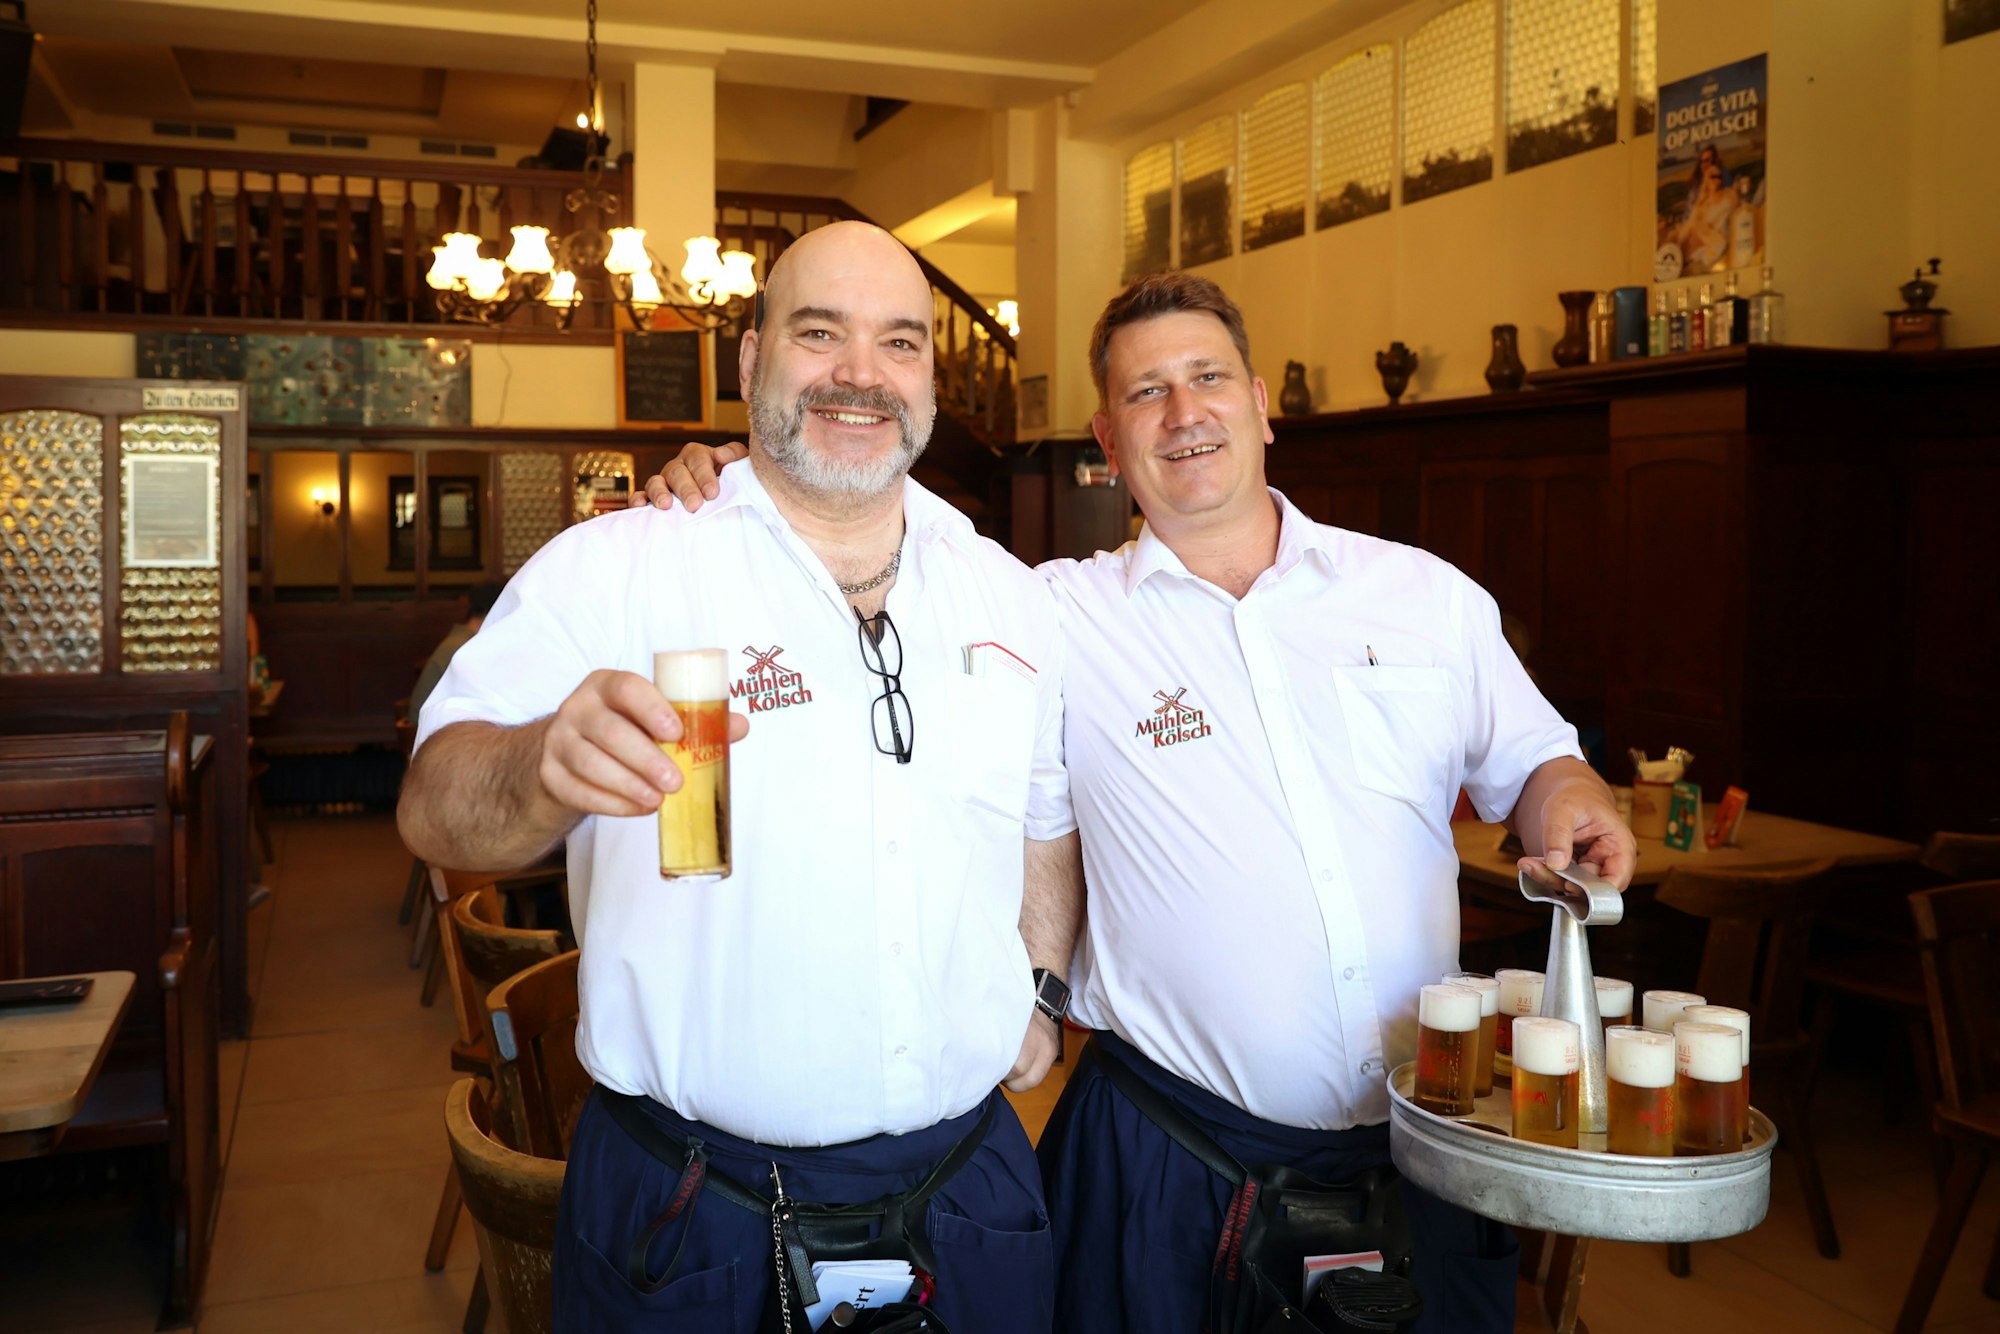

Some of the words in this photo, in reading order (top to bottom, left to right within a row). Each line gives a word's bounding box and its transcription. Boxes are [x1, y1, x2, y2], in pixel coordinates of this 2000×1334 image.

[1665, 97, 1716, 129] DOLCE
[1718, 86, 1760, 113] VITA
[1664, 128, 1689, 151] OP
[1690, 108, 1758, 143] KÖLSCH
[729, 668, 802, 698] Mühlen
[747, 684, 813, 714] Kölsch
[1135, 710, 1204, 738] Mühlen
[1153, 721, 1212, 748] Kölsch
